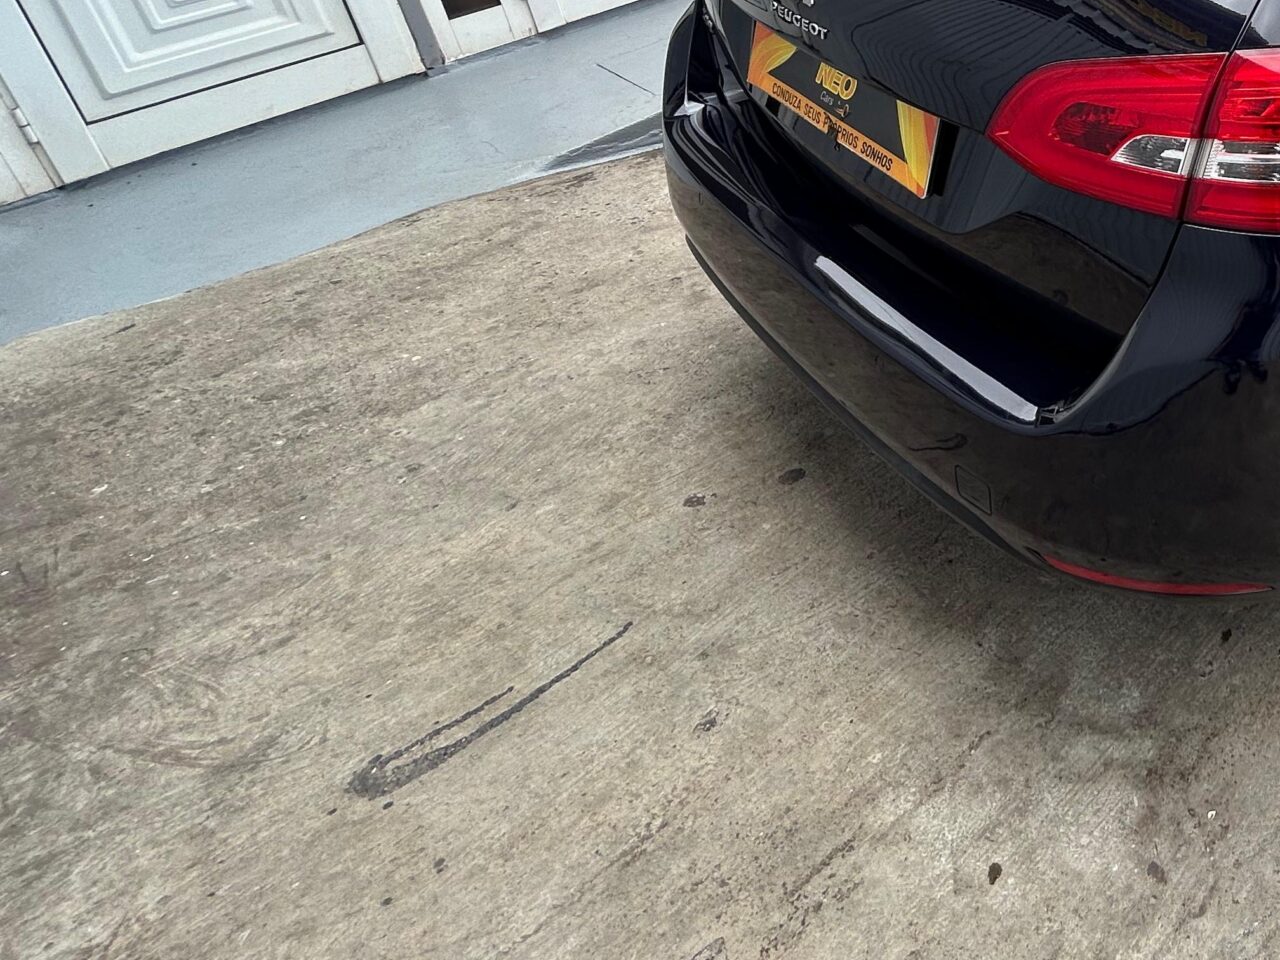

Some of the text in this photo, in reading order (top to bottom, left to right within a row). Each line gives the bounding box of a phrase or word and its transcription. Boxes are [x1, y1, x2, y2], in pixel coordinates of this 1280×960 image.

[771, 1, 828, 40] PEUGEOT
[815, 61, 858, 100] NEO
[820, 90, 834, 106] Cars
[772, 82, 893, 171] CONDUZA SEUS PPRIOS SONHOS
